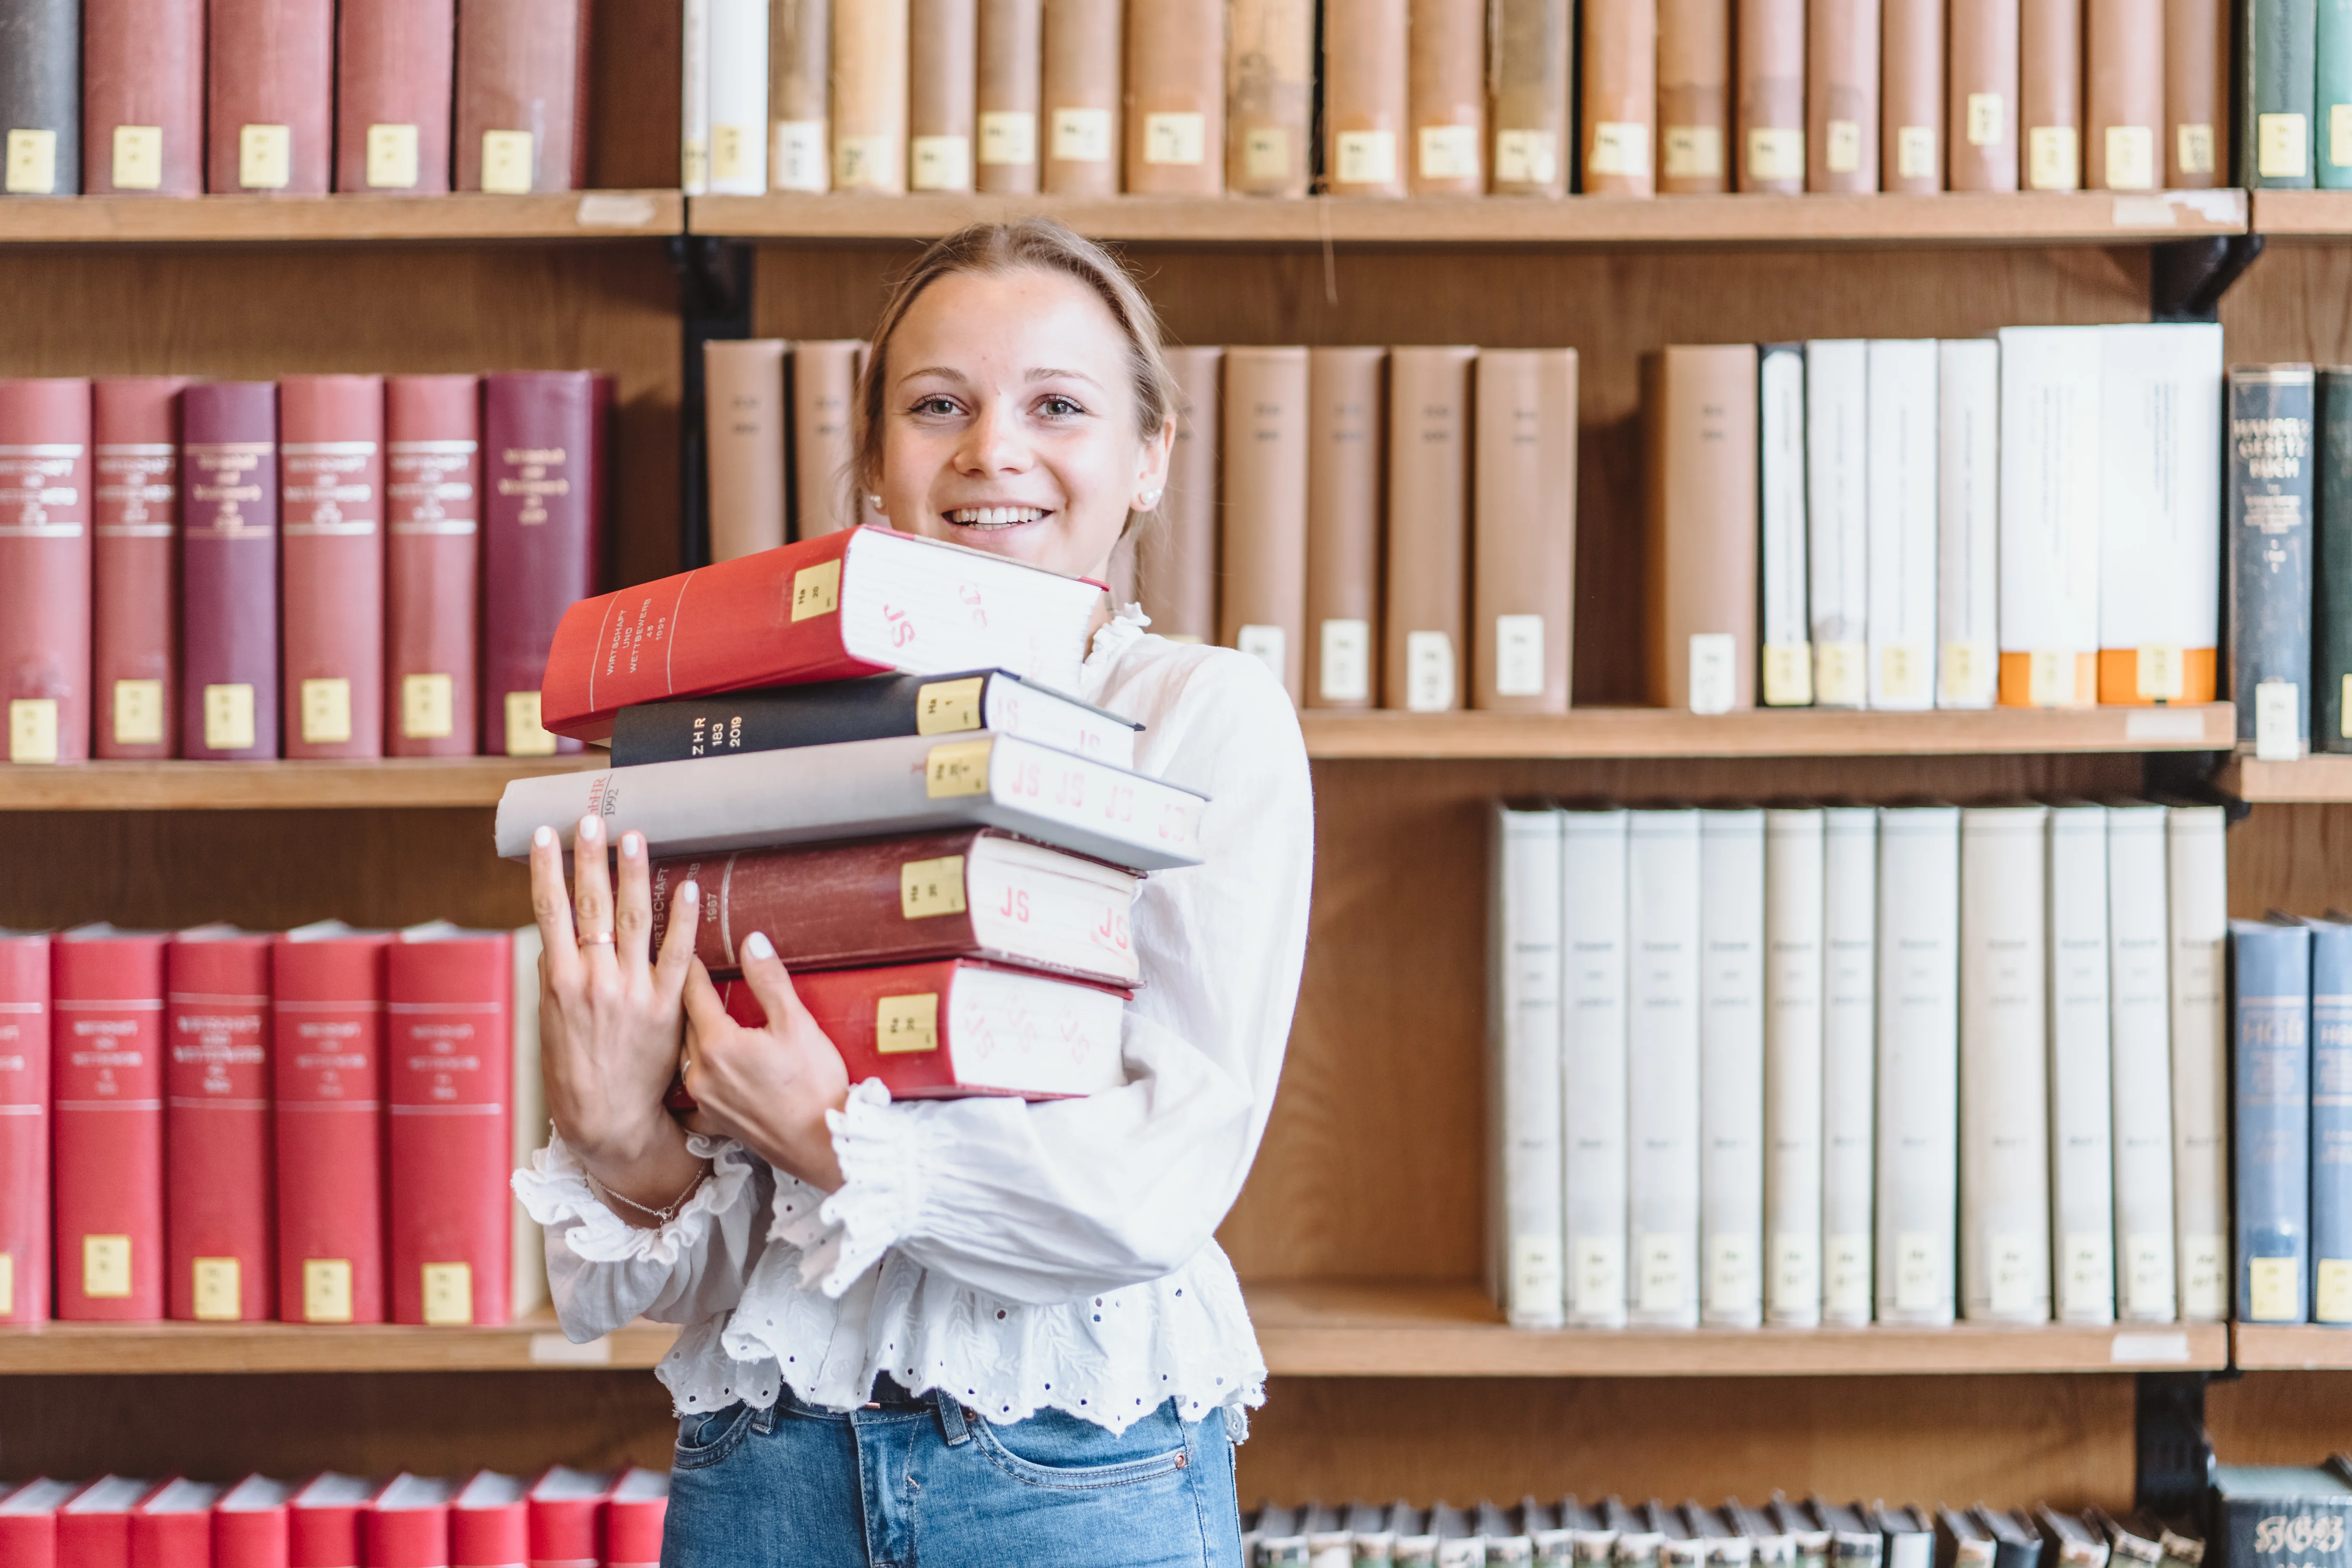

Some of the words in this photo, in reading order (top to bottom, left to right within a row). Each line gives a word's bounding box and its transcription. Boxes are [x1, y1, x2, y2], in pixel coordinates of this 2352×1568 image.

[607, 610, 627, 675] WIRTSCHAFT
[623, 627, 633, 648] UND
[630, 598, 652, 673] WETTBEWERB
[883, 603, 916, 648] JS
[712, 723, 723, 746] 183
[729, 716, 742, 747] 2019
[605, 788, 619, 816] 1992
[1011, 760, 1041, 797] JS
[1055, 770, 1085, 808] JS
[707, 893, 718, 922] 1967
[1000, 886, 1030, 923] JS
[1099, 907, 1129, 950] JS
